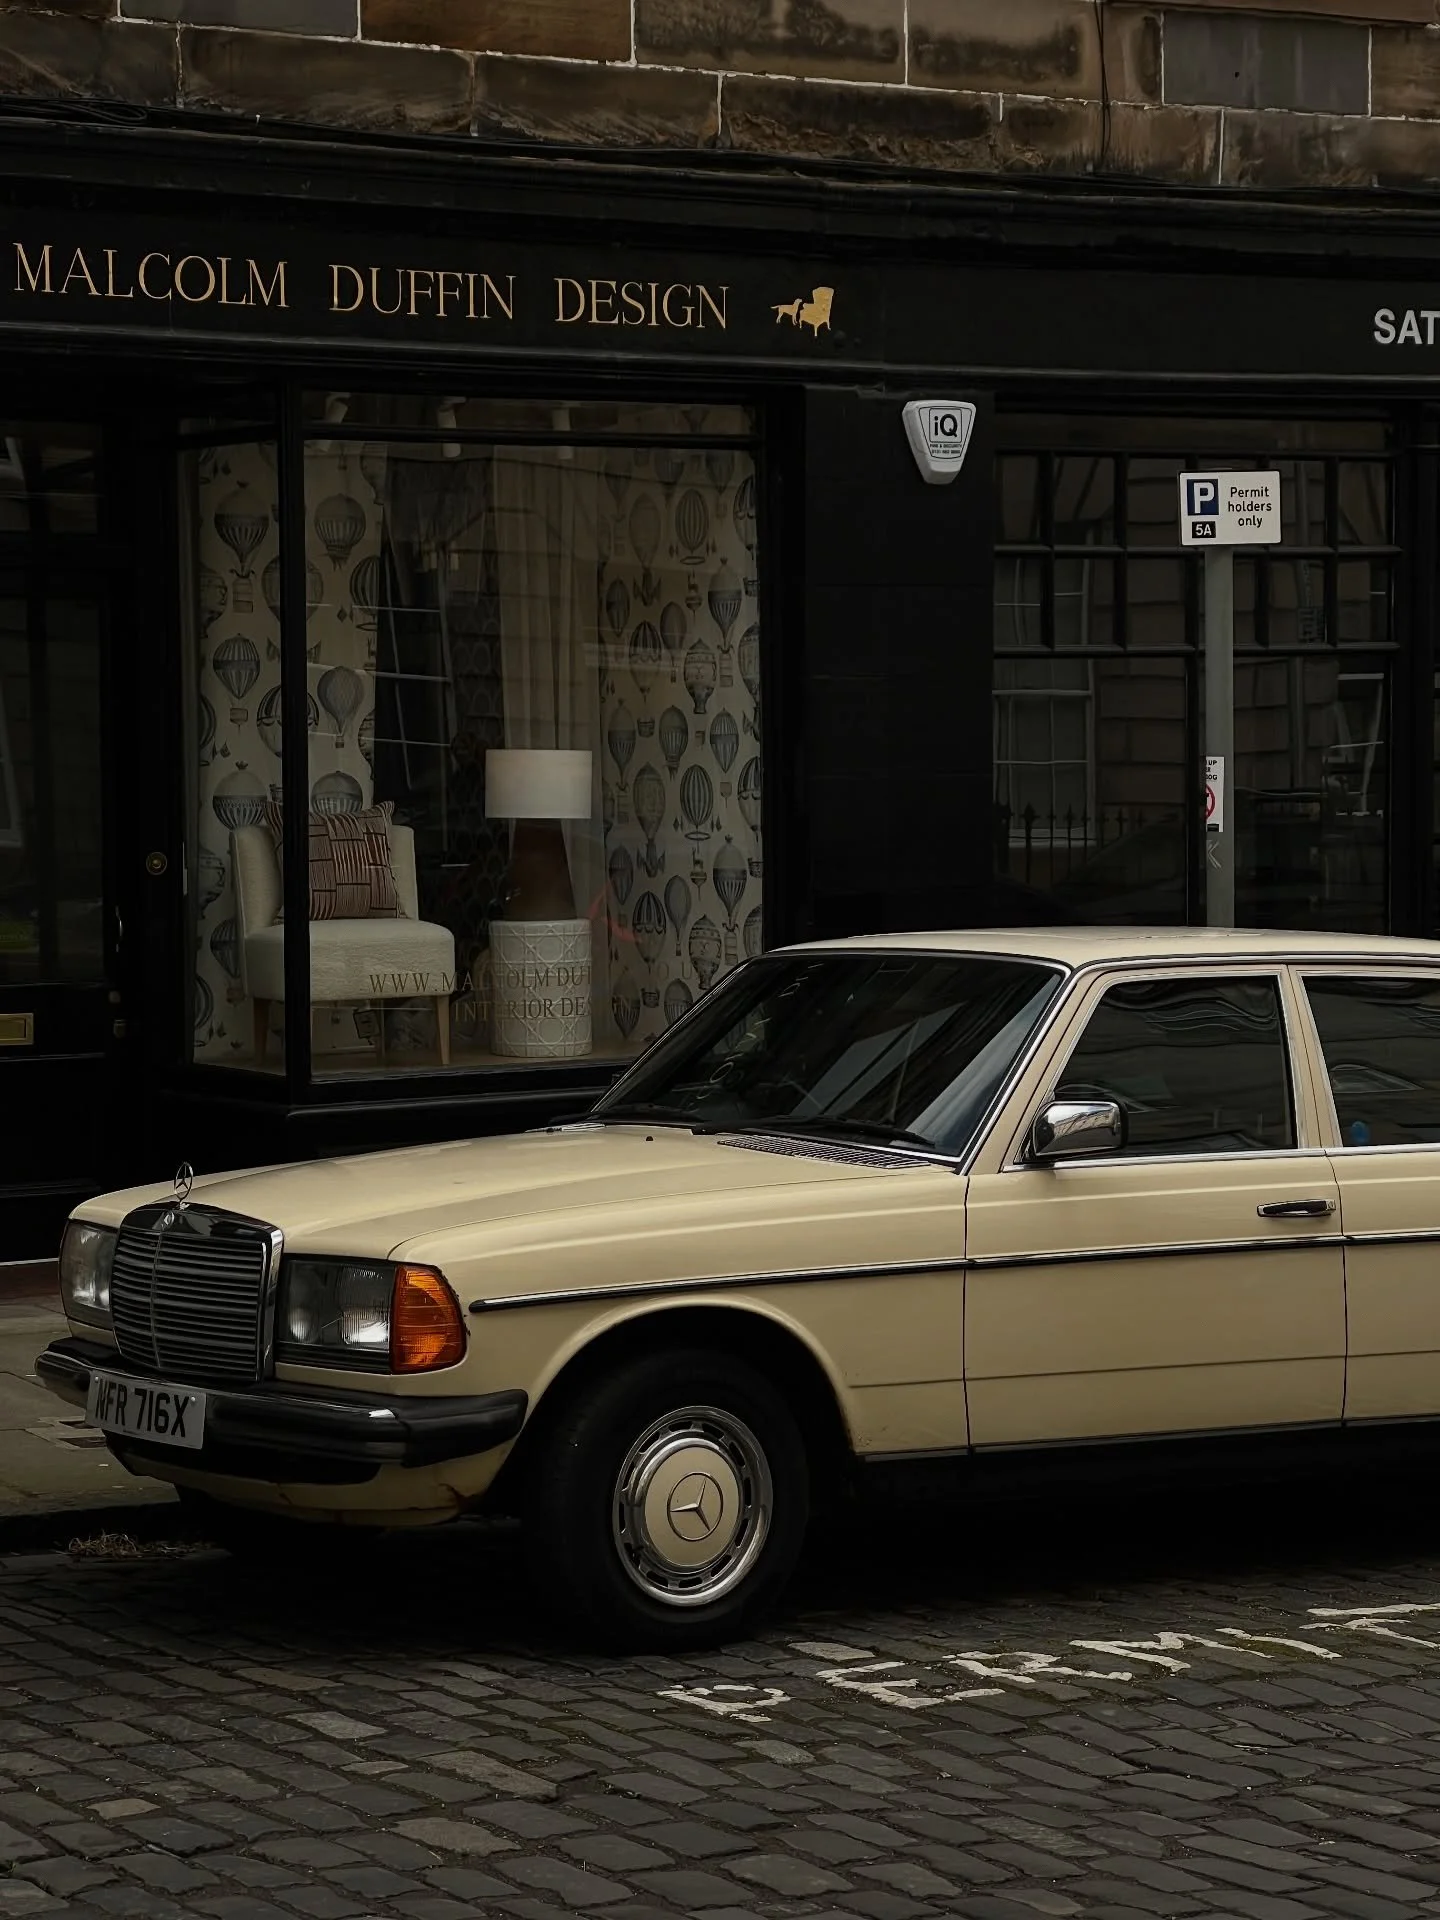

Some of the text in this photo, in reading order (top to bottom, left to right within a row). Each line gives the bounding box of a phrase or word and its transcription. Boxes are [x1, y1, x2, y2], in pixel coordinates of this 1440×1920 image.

[13, 242, 730, 330] MALCOLM DUFFIN DESIGN
[1374, 308, 1440, 345] SAT
[934, 414, 958, 437] iQ
[1193, 482, 1215, 514] P
[1230, 486, 1270, 498] Permit
[1227, 500, 1272, 513] holders
[1195, 523, 1212, 536] 5A
[1237, 514, 1263, 529] only
[454, 998, 555, 1023] INTRIOR
[95, 1378, 190, 1438] NFR 716X
